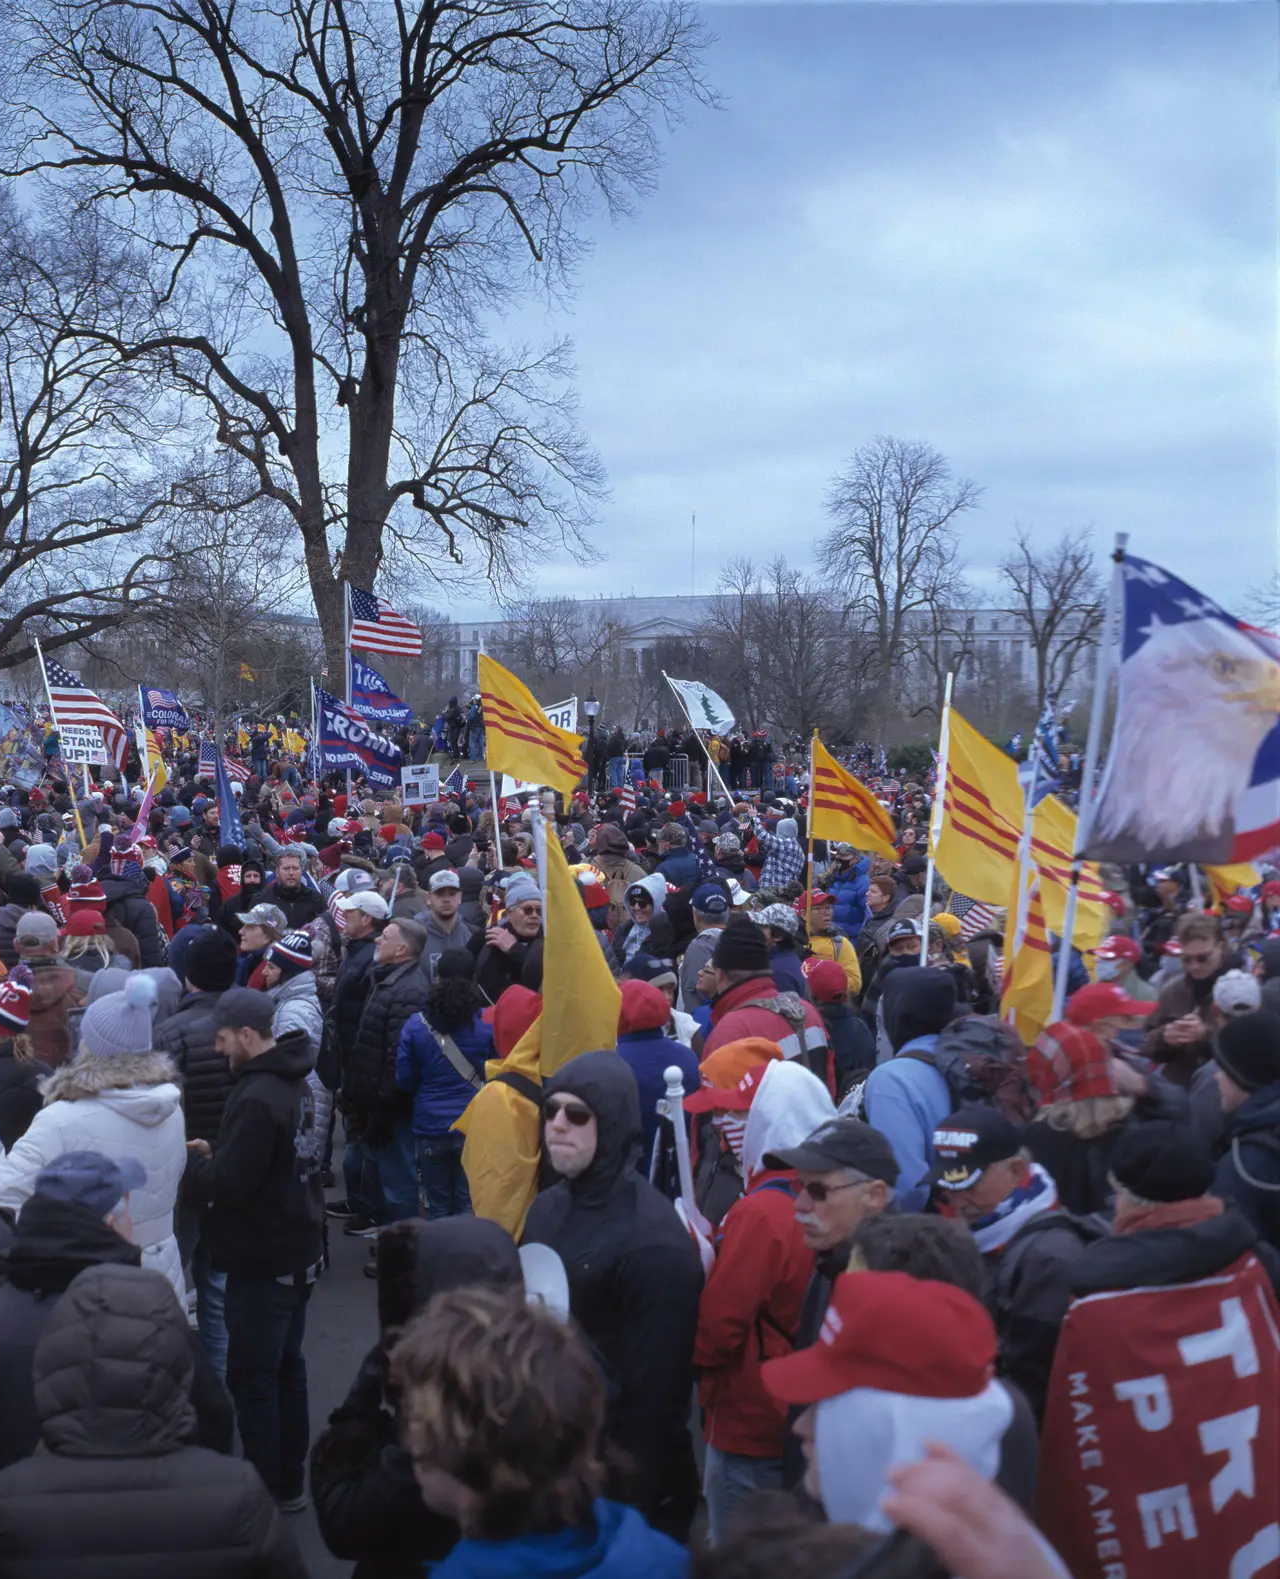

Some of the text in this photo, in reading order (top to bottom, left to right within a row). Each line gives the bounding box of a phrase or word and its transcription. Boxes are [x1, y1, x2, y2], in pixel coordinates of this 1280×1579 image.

[549, 709, 571, 728] OR
[61, 725, 90, 735] NEEDS
[62, 736, 104, 748] STAND
[64, 748, 90, 761] UP!
[1067, 1371, 1104, 1470] MAKE
